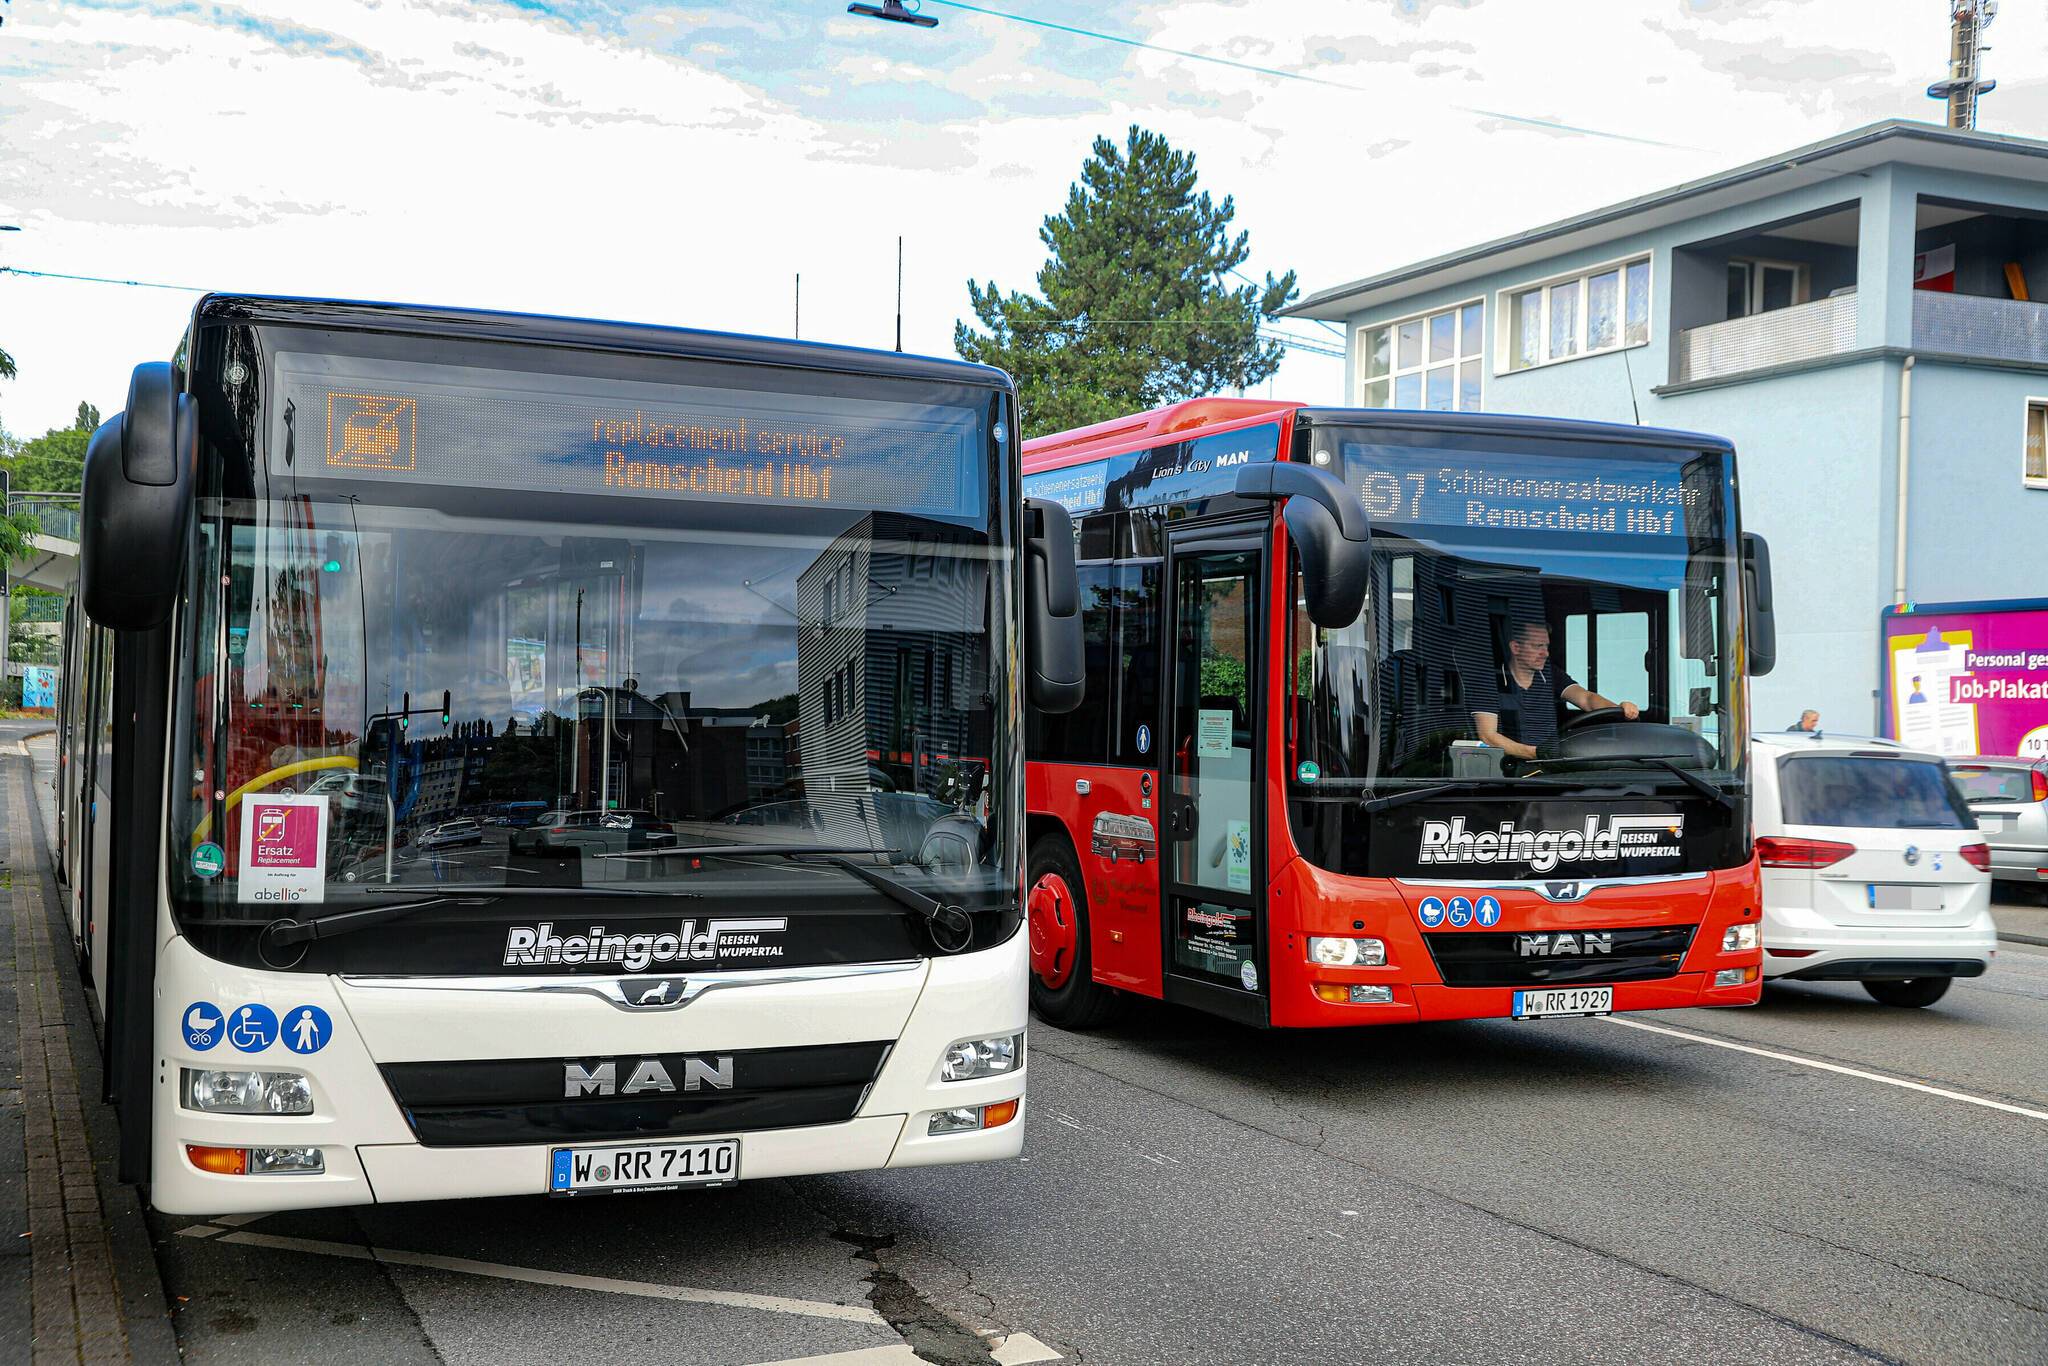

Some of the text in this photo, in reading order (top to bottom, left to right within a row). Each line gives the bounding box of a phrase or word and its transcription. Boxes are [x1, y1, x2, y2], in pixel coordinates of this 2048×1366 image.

[593, 409, 846, 459] replacement service
[1216, 450, 1249, 468] MAN
[604, 451, 832, 500] Remscheid Hbf
[1152, 459, 1212, 480] Lion's City
[1438, 467, 1701, 507] Schienenersatzverkehr
[1466, 500, 1676, 535] Remscheid Hbf
[1967, 651, 2026, 668] Personal
[1953, 678, 2048, 703] Job-Plakat
[2027, 739, 2041, 751] 10
[1418, 814, 1684, 873] Rheingold
[1620, 832, 1658, 844] REISEN
[203, 847, 212, 861] 4
[258, 845, 293, 856] Ersatz
[1620, 845, 1681, 857] WUPPERTAL
[257, 857, 301, 865] Replacement
[254, 887, 300, 901] abellio
[503, 917, 788, 973] Rheingold
[719, 934, 759, 945] REISEN
[1518, 933, 1612, 957] MAN
[719, 946, 784, 957] WUPPERTAL
[1525, 990, 1609, 1012] W RR 1929
[563, 1056, 734, 1098] MAN
[575, 1146, 732, 1183] W RR 7110
[558, 1173, 566, 1182] D
